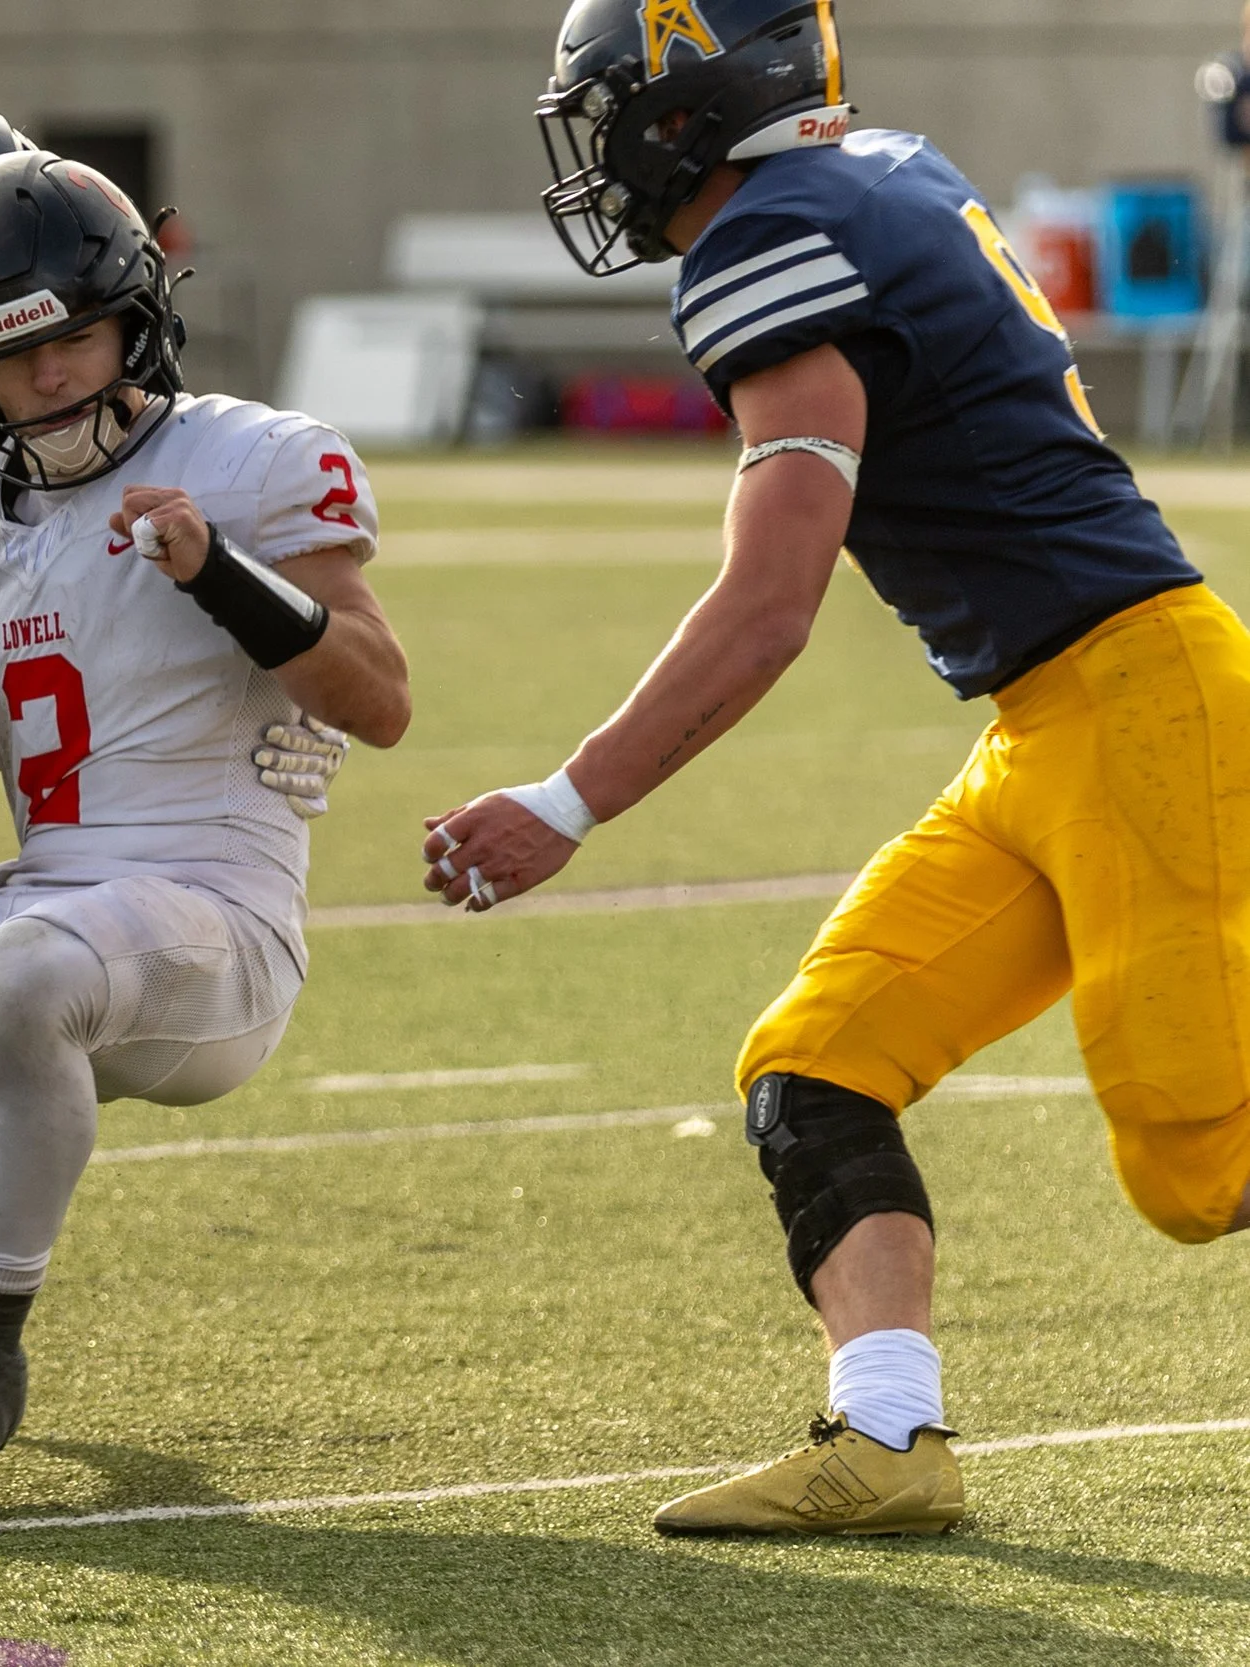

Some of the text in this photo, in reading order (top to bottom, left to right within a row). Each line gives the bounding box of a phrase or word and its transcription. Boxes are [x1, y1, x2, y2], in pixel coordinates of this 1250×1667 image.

[799, 115, 848, 140] Ridd
[312, 453, 360, 529] 2
[2, 612, 66, 650] LOWELL
[2, 653, 92, 826] 2
